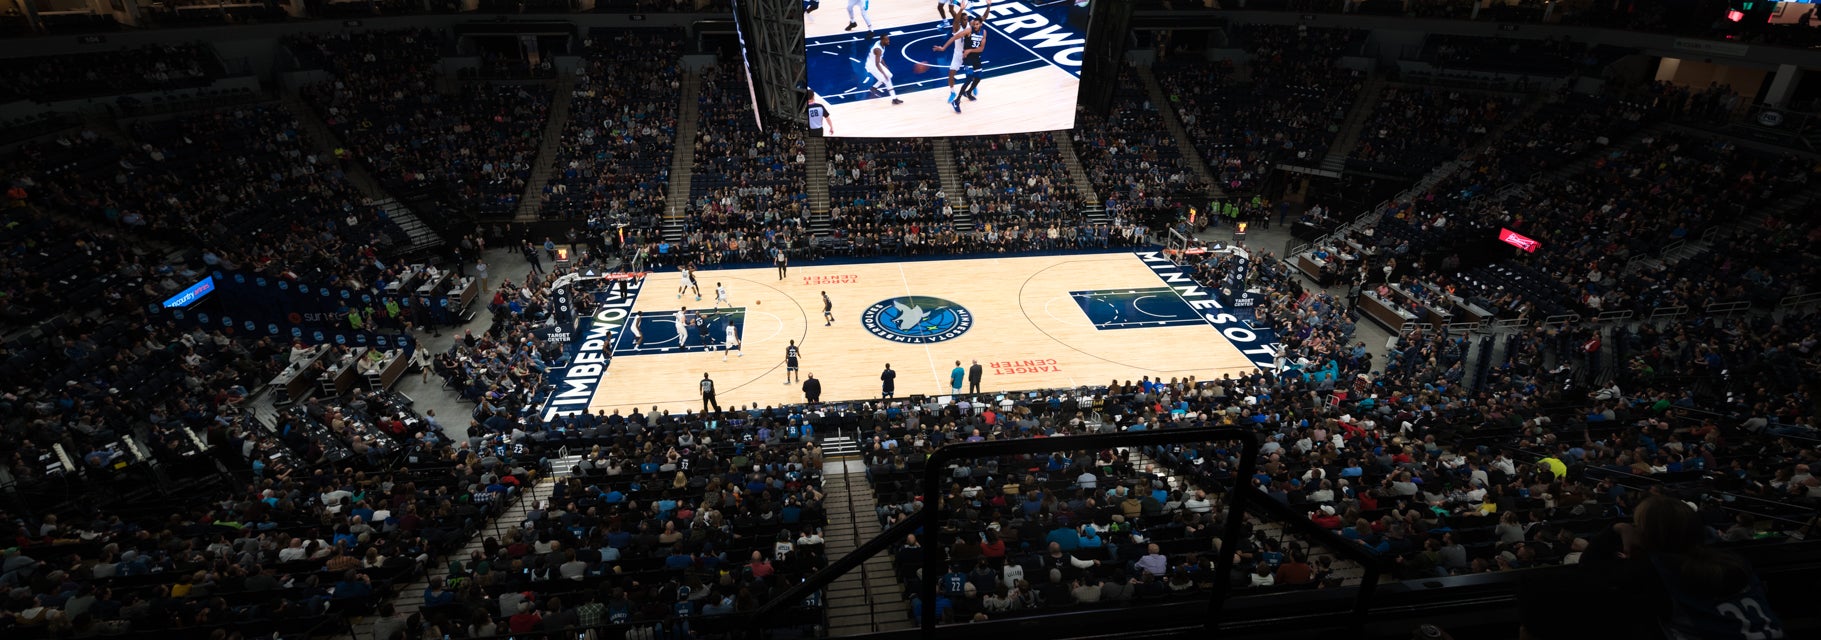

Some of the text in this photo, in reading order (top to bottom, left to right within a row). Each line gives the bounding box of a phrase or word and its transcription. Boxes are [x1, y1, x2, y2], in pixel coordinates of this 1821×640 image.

[543, 272, 646, 422] TIMBERWOLVE
[990, 359, 1057, 368] CENTER
[994, 366, 1062, 375] TARGET
[951, 582, 961, 591] 22
